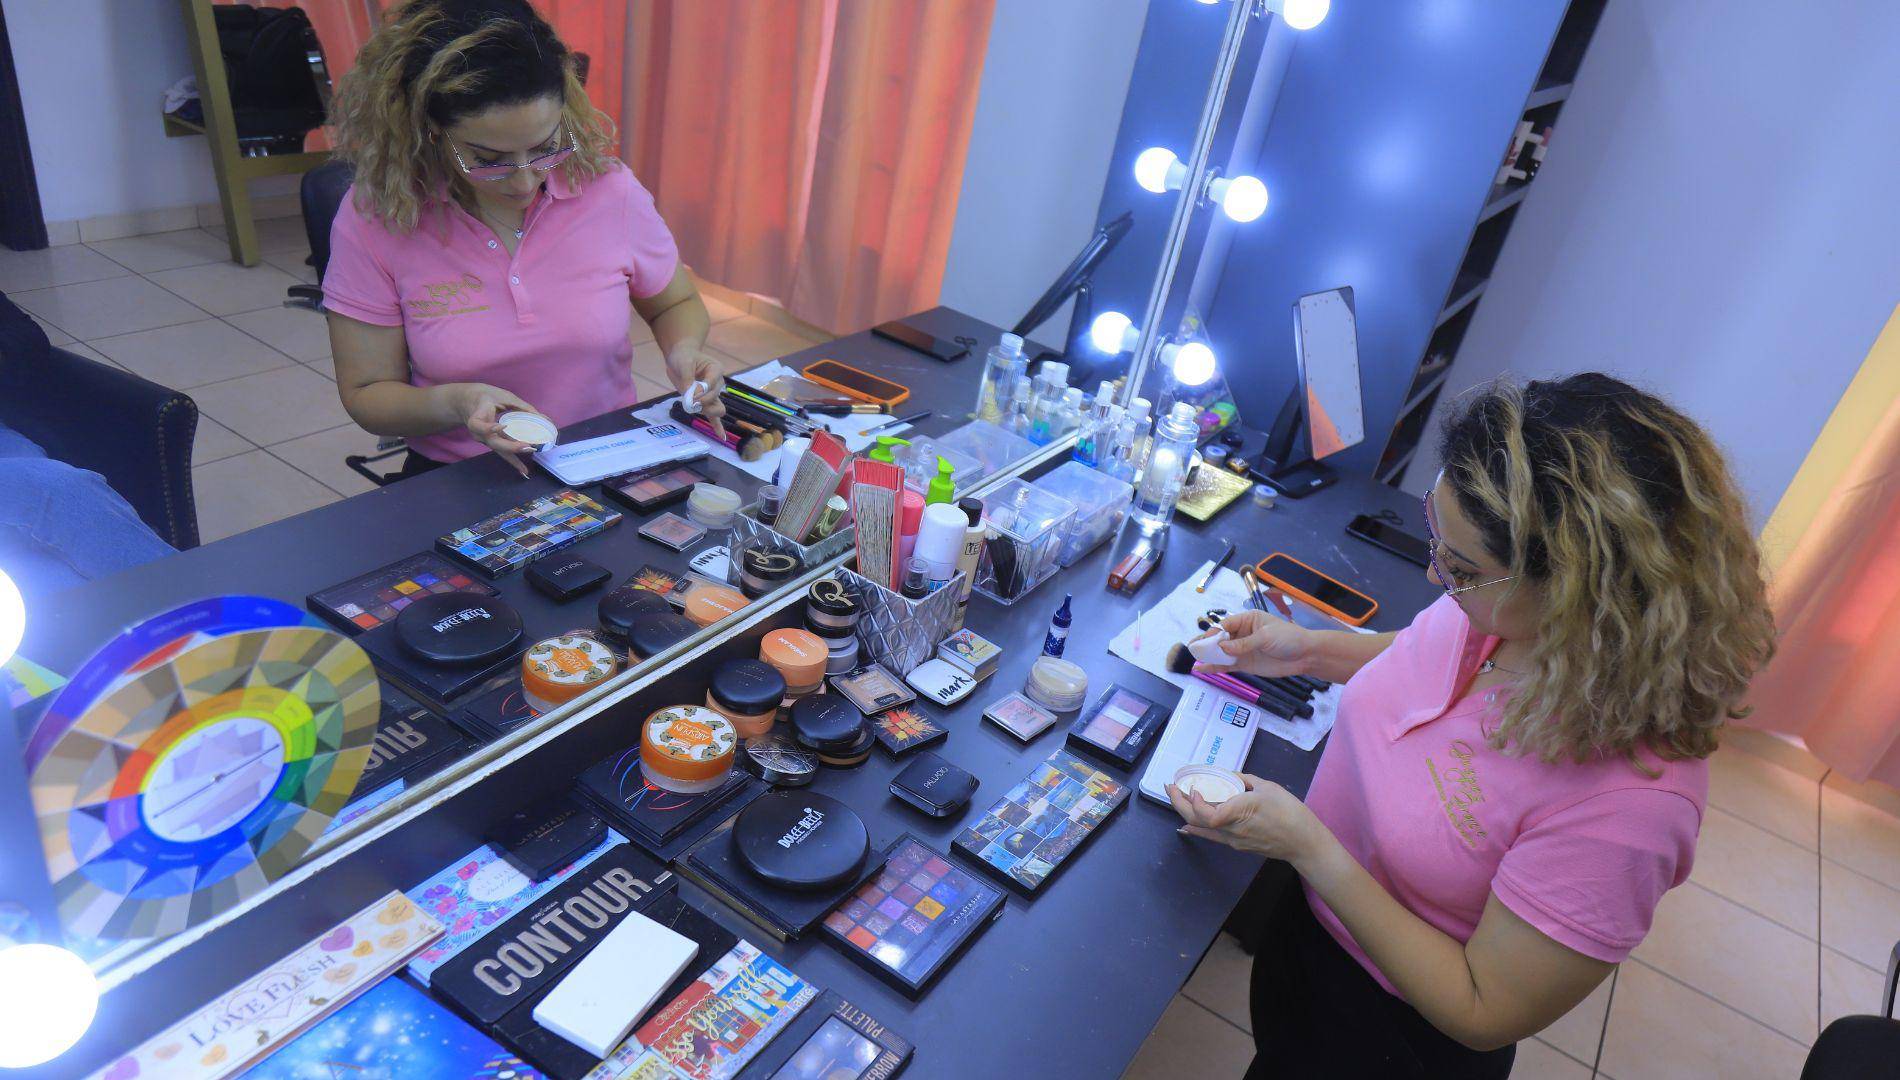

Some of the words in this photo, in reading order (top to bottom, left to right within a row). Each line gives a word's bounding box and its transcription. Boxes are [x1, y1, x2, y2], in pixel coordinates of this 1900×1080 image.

[777, 825, 806, 849] DOLCE
[472, 867, 653, 997] CONTOUR
[190, 998, 265, 1047] LOVE
[834, 1000, 885, 1039] PALETTE
